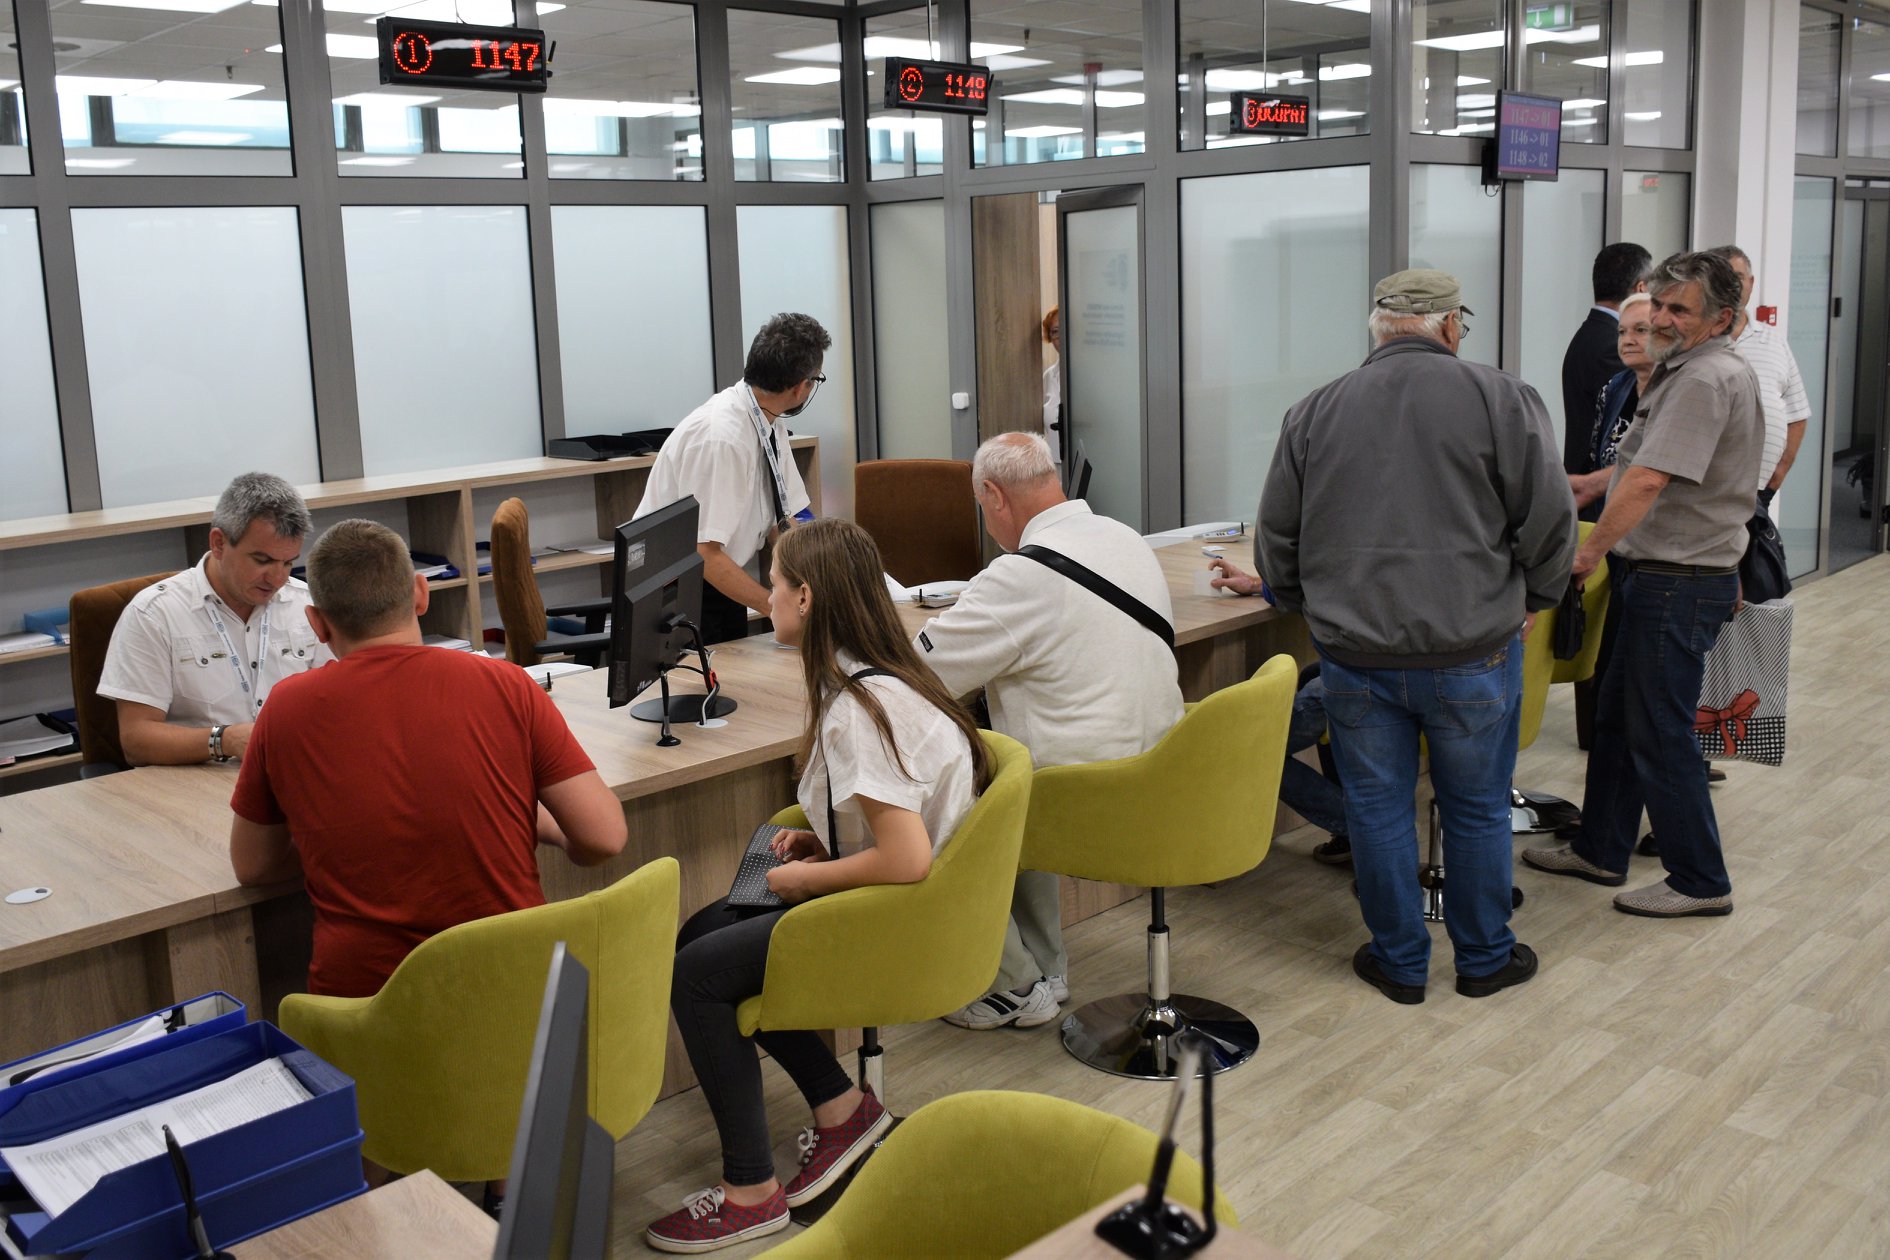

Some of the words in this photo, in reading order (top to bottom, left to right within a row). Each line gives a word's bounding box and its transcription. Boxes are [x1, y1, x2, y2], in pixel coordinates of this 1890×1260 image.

[471, 40, 539, 71] 1147
[1510, 128, 1528, 145] 1146
[1539, 132, 1549, 147] 01
[1509, 150, 1528, 166] 1148
[1538, 151, 1548, 168] 02
